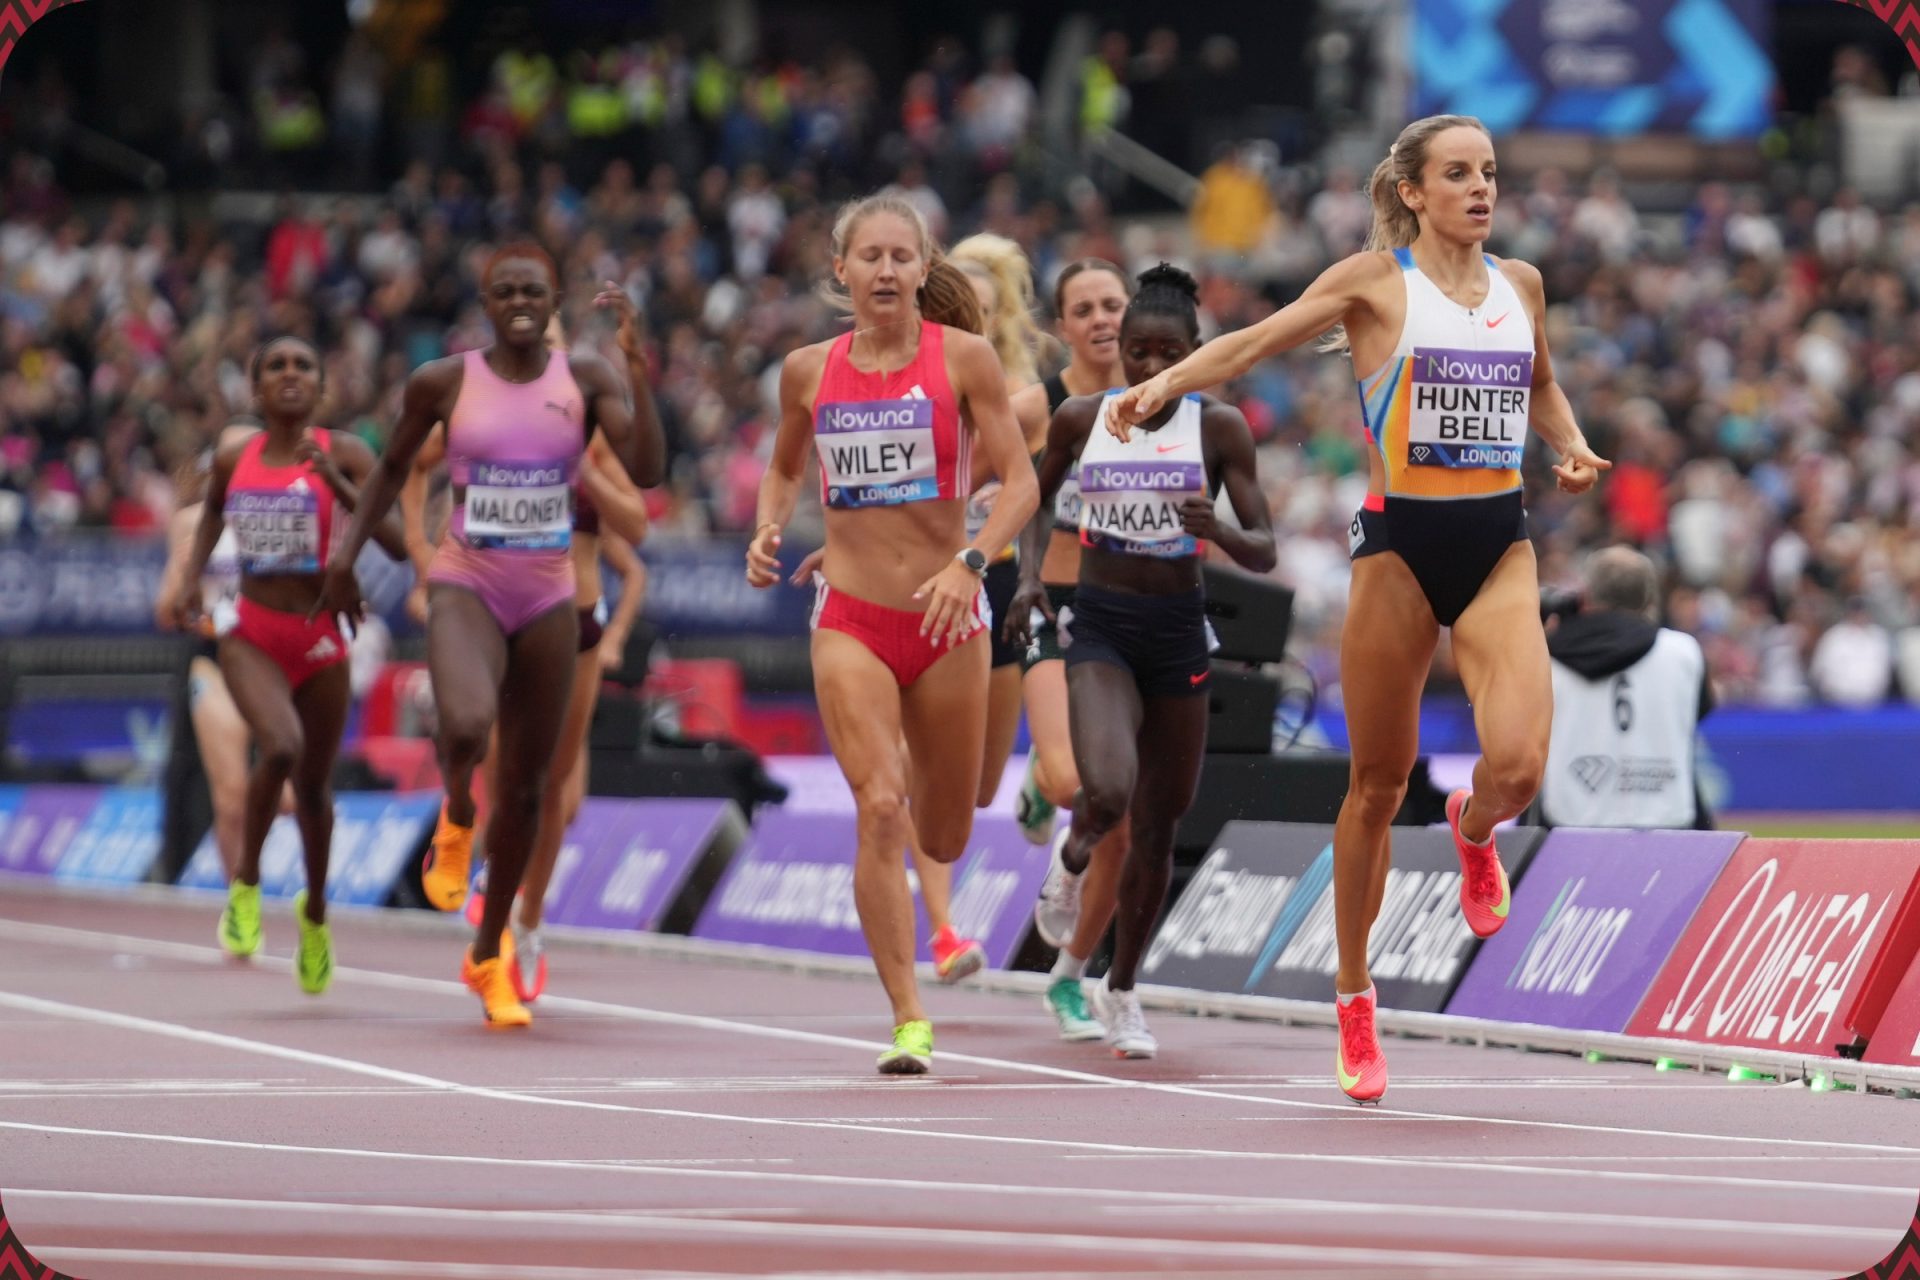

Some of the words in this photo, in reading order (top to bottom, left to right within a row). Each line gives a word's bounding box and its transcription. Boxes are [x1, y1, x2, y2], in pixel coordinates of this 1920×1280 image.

[1427, 355, 1521, 382] Novuna
[1417, 386, 1525, 414] HUNTER
[825, 407, 914, 429] Novuna
[1439, 415, 1513, 441] BELL
[830, 442, 916, 475] WILEY
[1460, 448, 1521, 464] LONDON
[479, 463, 561, 486] Novuna
[1091, 467, 1185, 488] Novuna
[858, 482, 921, 501] LONDON
[470, 495, 565, 524] MALONEY
[1614, 672, 1634, 733] 6
[1706, 888, 1895, 1044] OMEGA
